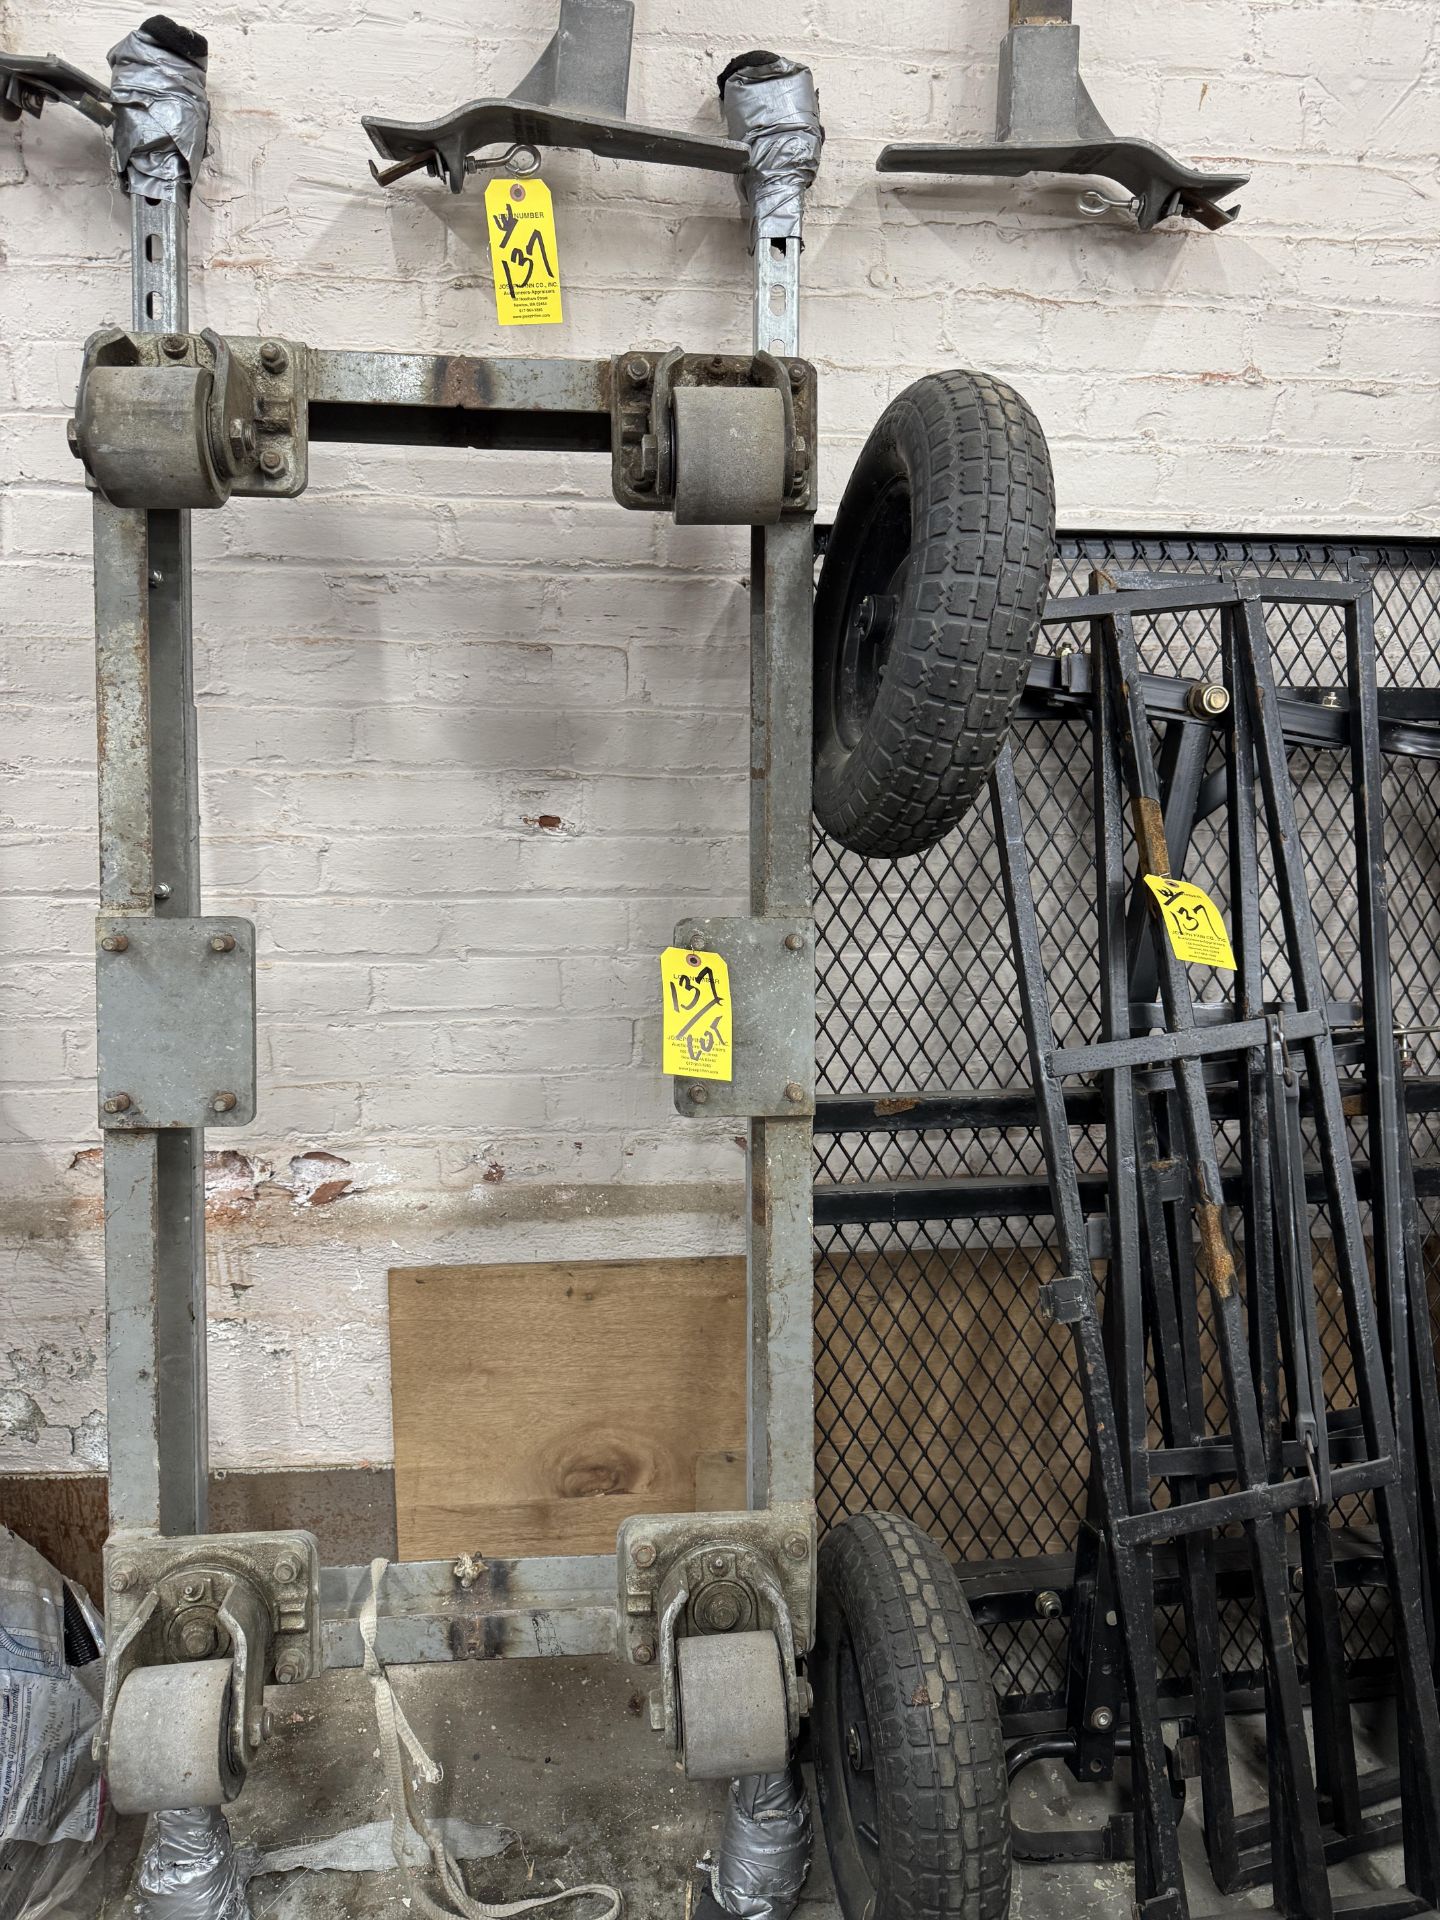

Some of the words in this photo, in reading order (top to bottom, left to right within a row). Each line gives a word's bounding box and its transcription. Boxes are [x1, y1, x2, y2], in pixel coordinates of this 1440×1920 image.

[501, 229, 555, 299] 137
[1170, 904, 1222, 940] 137
[670, 966, 724, 1013] 137
